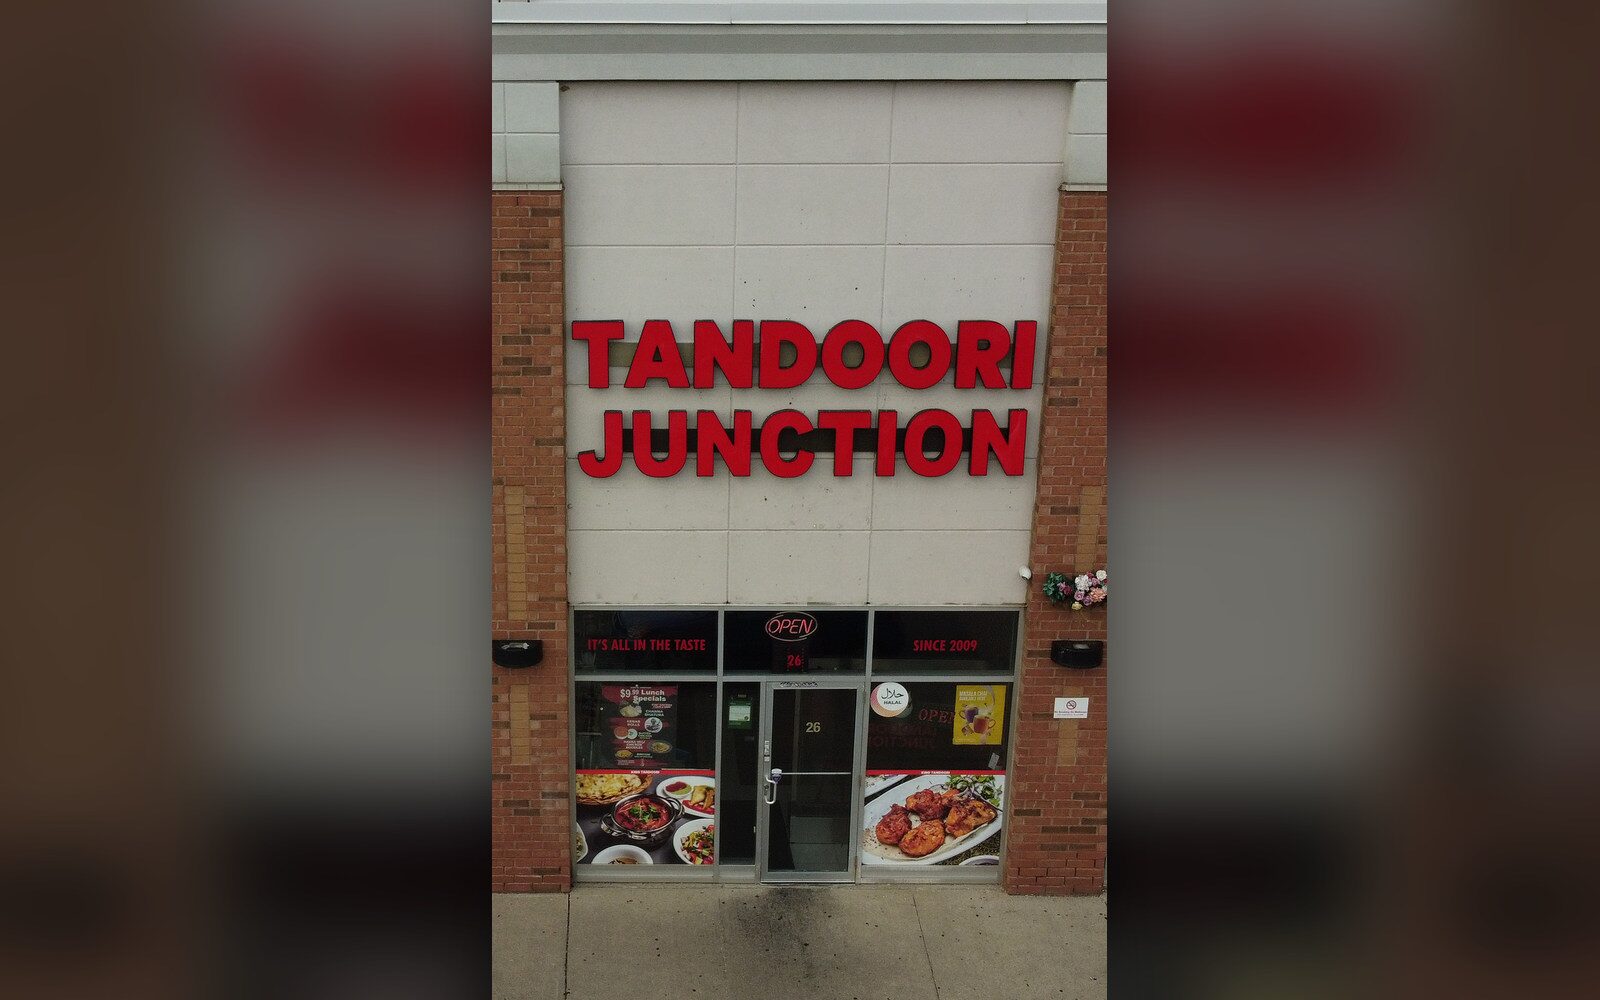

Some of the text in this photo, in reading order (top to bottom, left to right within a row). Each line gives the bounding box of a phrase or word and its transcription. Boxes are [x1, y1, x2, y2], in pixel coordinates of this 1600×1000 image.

[571, 319, 1038, 389] TANDOORI
[577, 408, 1028, 478] JUNCTION
[767, 619, 813, 634] OPEN
[588, 639, 706, 651] IT'S ALL IN THE TASTE
[913, 639, 978, 651] SINCE 2009
[787, 655, 801, 666] 26
[881, 688, 904, 699] حلال
[805, 721, 821, 733] 26
